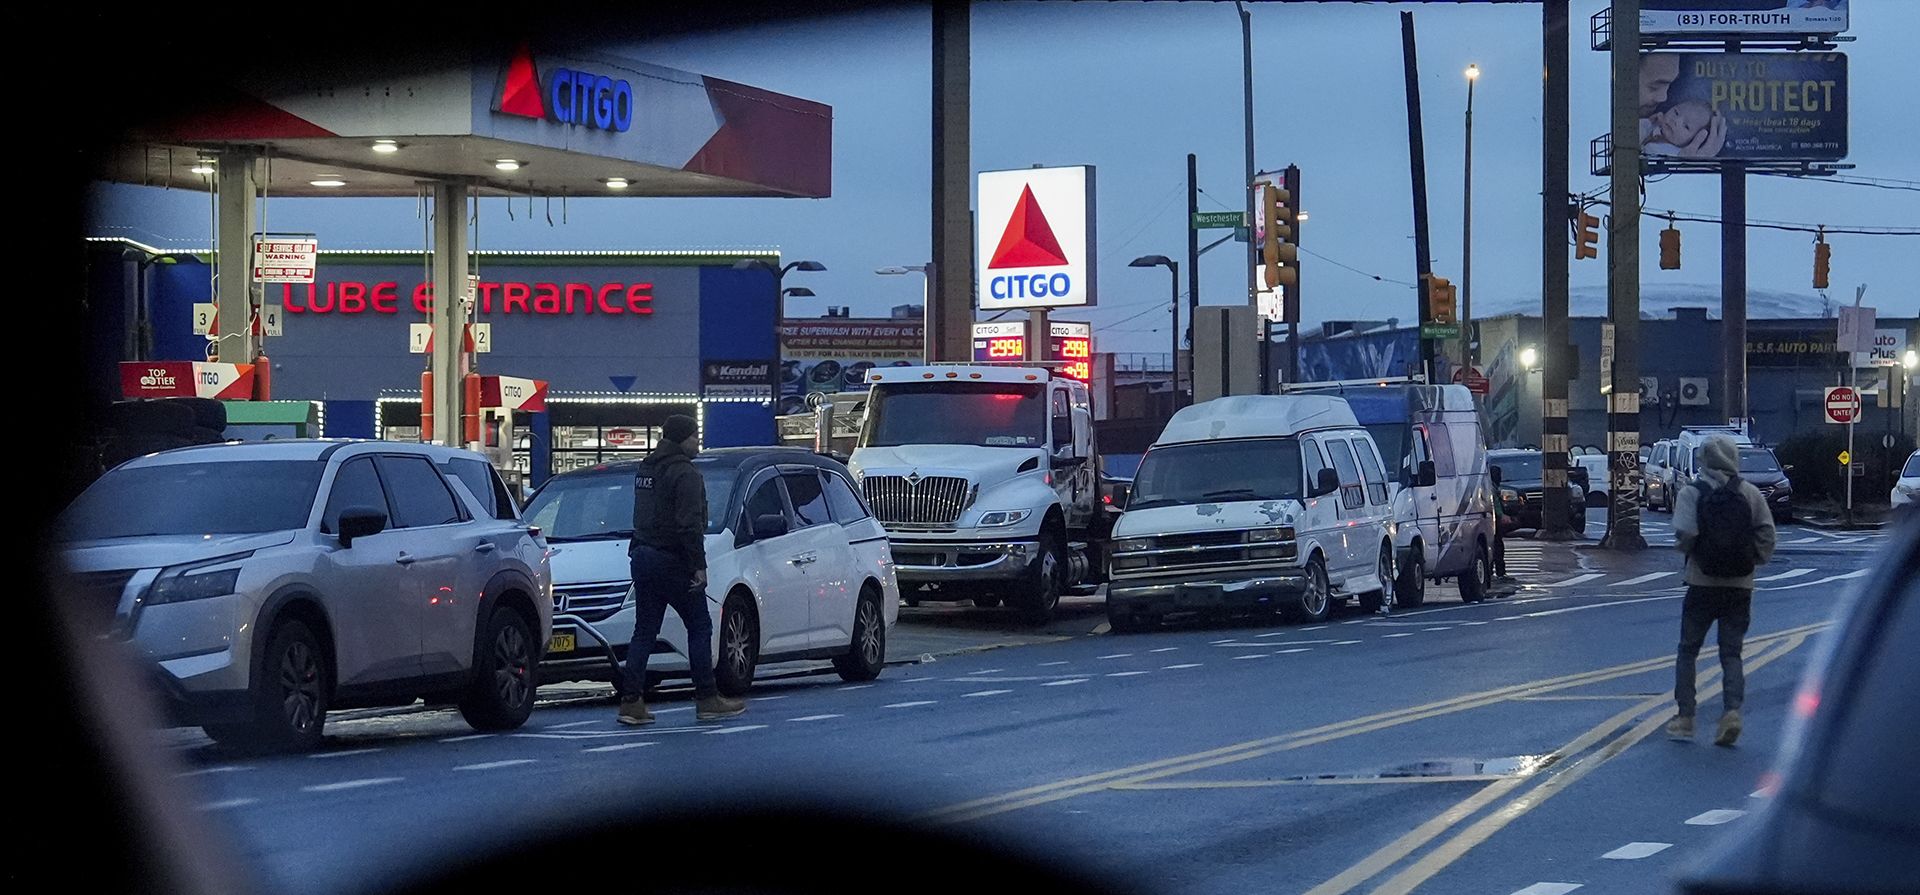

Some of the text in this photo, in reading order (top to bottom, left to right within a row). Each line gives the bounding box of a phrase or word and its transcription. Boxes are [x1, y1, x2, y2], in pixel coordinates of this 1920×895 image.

[1677, 14, 1791, 26] (83) FOR-TRUTH
[1696, 61, 1766, 78] DUTY TO
[551, 67, 633, 133] CITGO
[1712, 80, 1836, 112] PROTECT
[1789, 117, 1800, 126] 18
[1800, 117, 1821, 129] days
[1196, 213, 1241, 223] Westchester
[990, 272, 1071, 300] CITGO
[282, 281, 398, 314] LUBE
[413, 281, 654, 315] ETRANCE
[199, 313, 207, 326] 3
[267, 313, 275, 327] 4
[799, 327, 850, 336] SUPERWASH
[851, 327, 873, 336] WITH
[873, 327, 899, 336] EVERY
[976, 326, 999, 335] CITGO
[1051, 327, 1070, 335] CITGO
[416, 333, 422, 345] 1
[478, 331, 486, 344] 2
[1873, 335, 1896, 346] uto
[1777, 342, 1807, 353] AUTO
[1870, 347, 1896, 359] Plus
[148, 368, 166, 377] TOP
[719, 364, 768, 376] Kendall
[155, 376, 176, 386] TIER
[198, 372, 219, 385] CITGO
[504, 385, 522, 398] CITGO
[635, 477, 653, 489] POLICE
